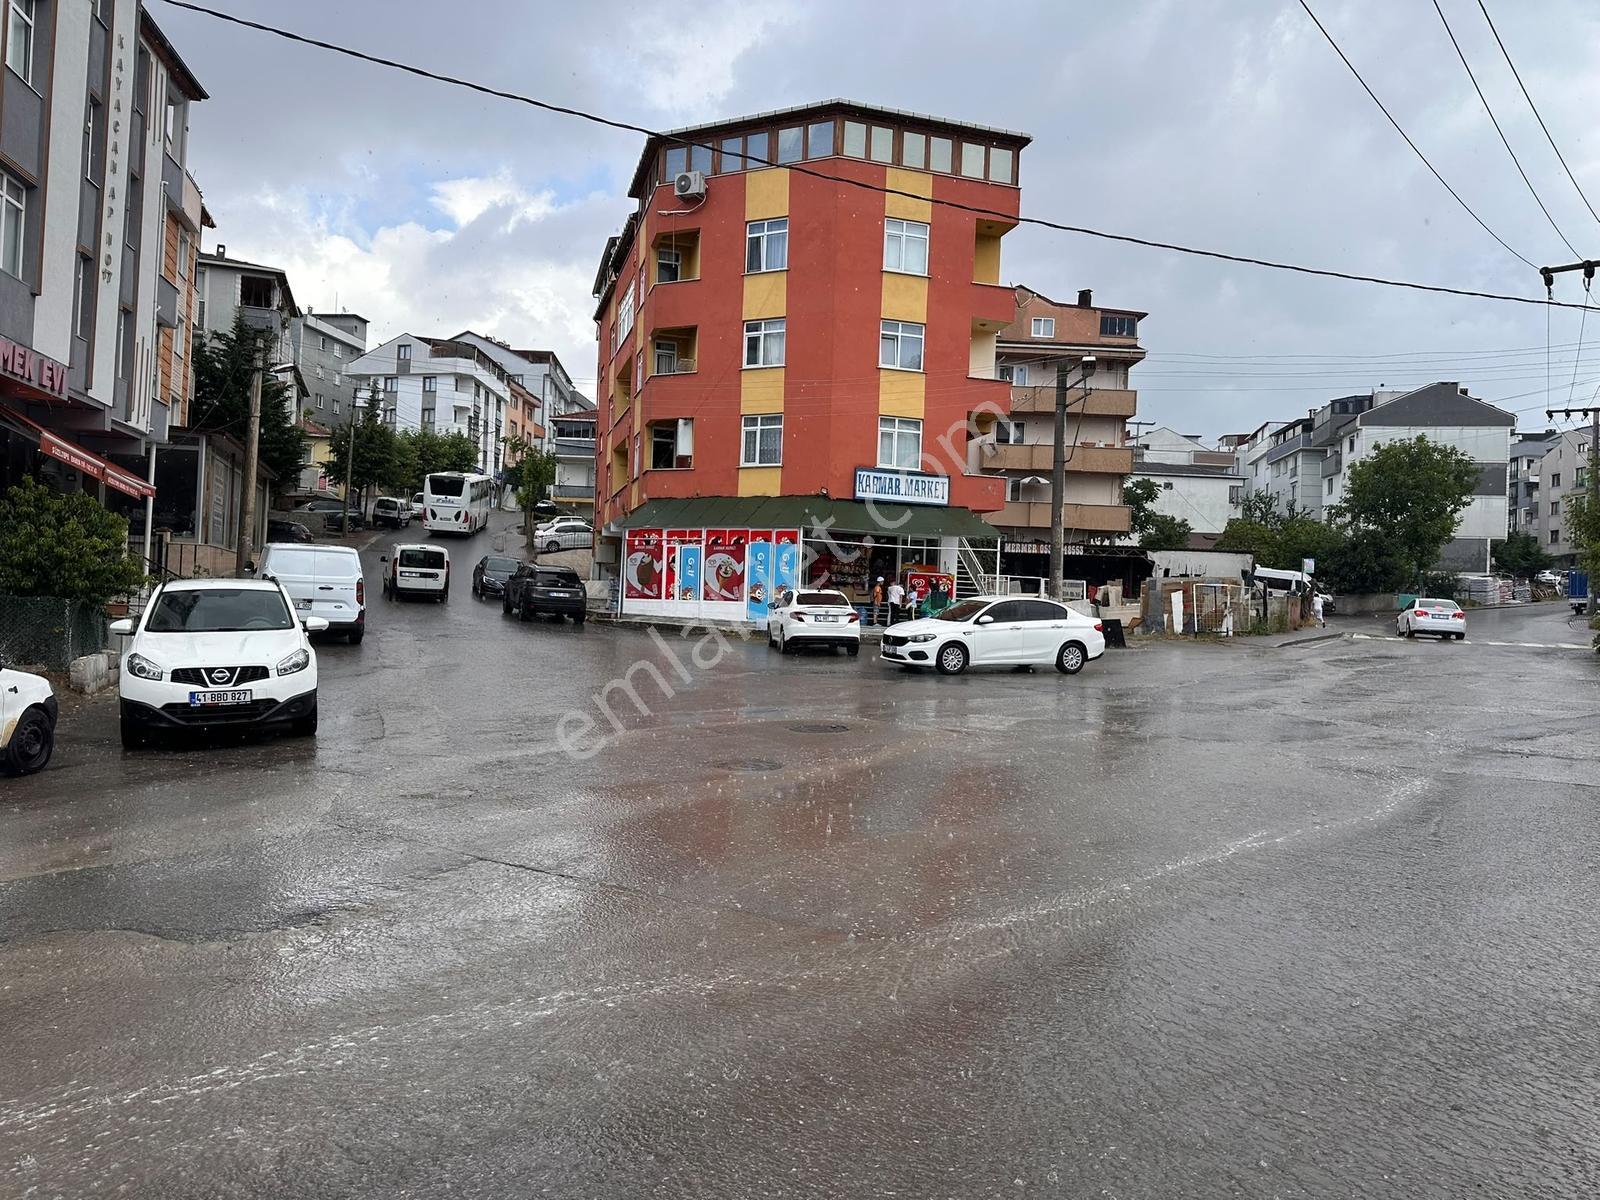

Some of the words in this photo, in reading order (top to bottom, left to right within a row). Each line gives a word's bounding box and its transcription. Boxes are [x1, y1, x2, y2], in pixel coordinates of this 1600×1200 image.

[1004, 543, 1038, 554] MERMER
[196, 693, 207, 703] 41
[210, 692, 228, 702] BBD
[230, 691, 247, 701] 827
